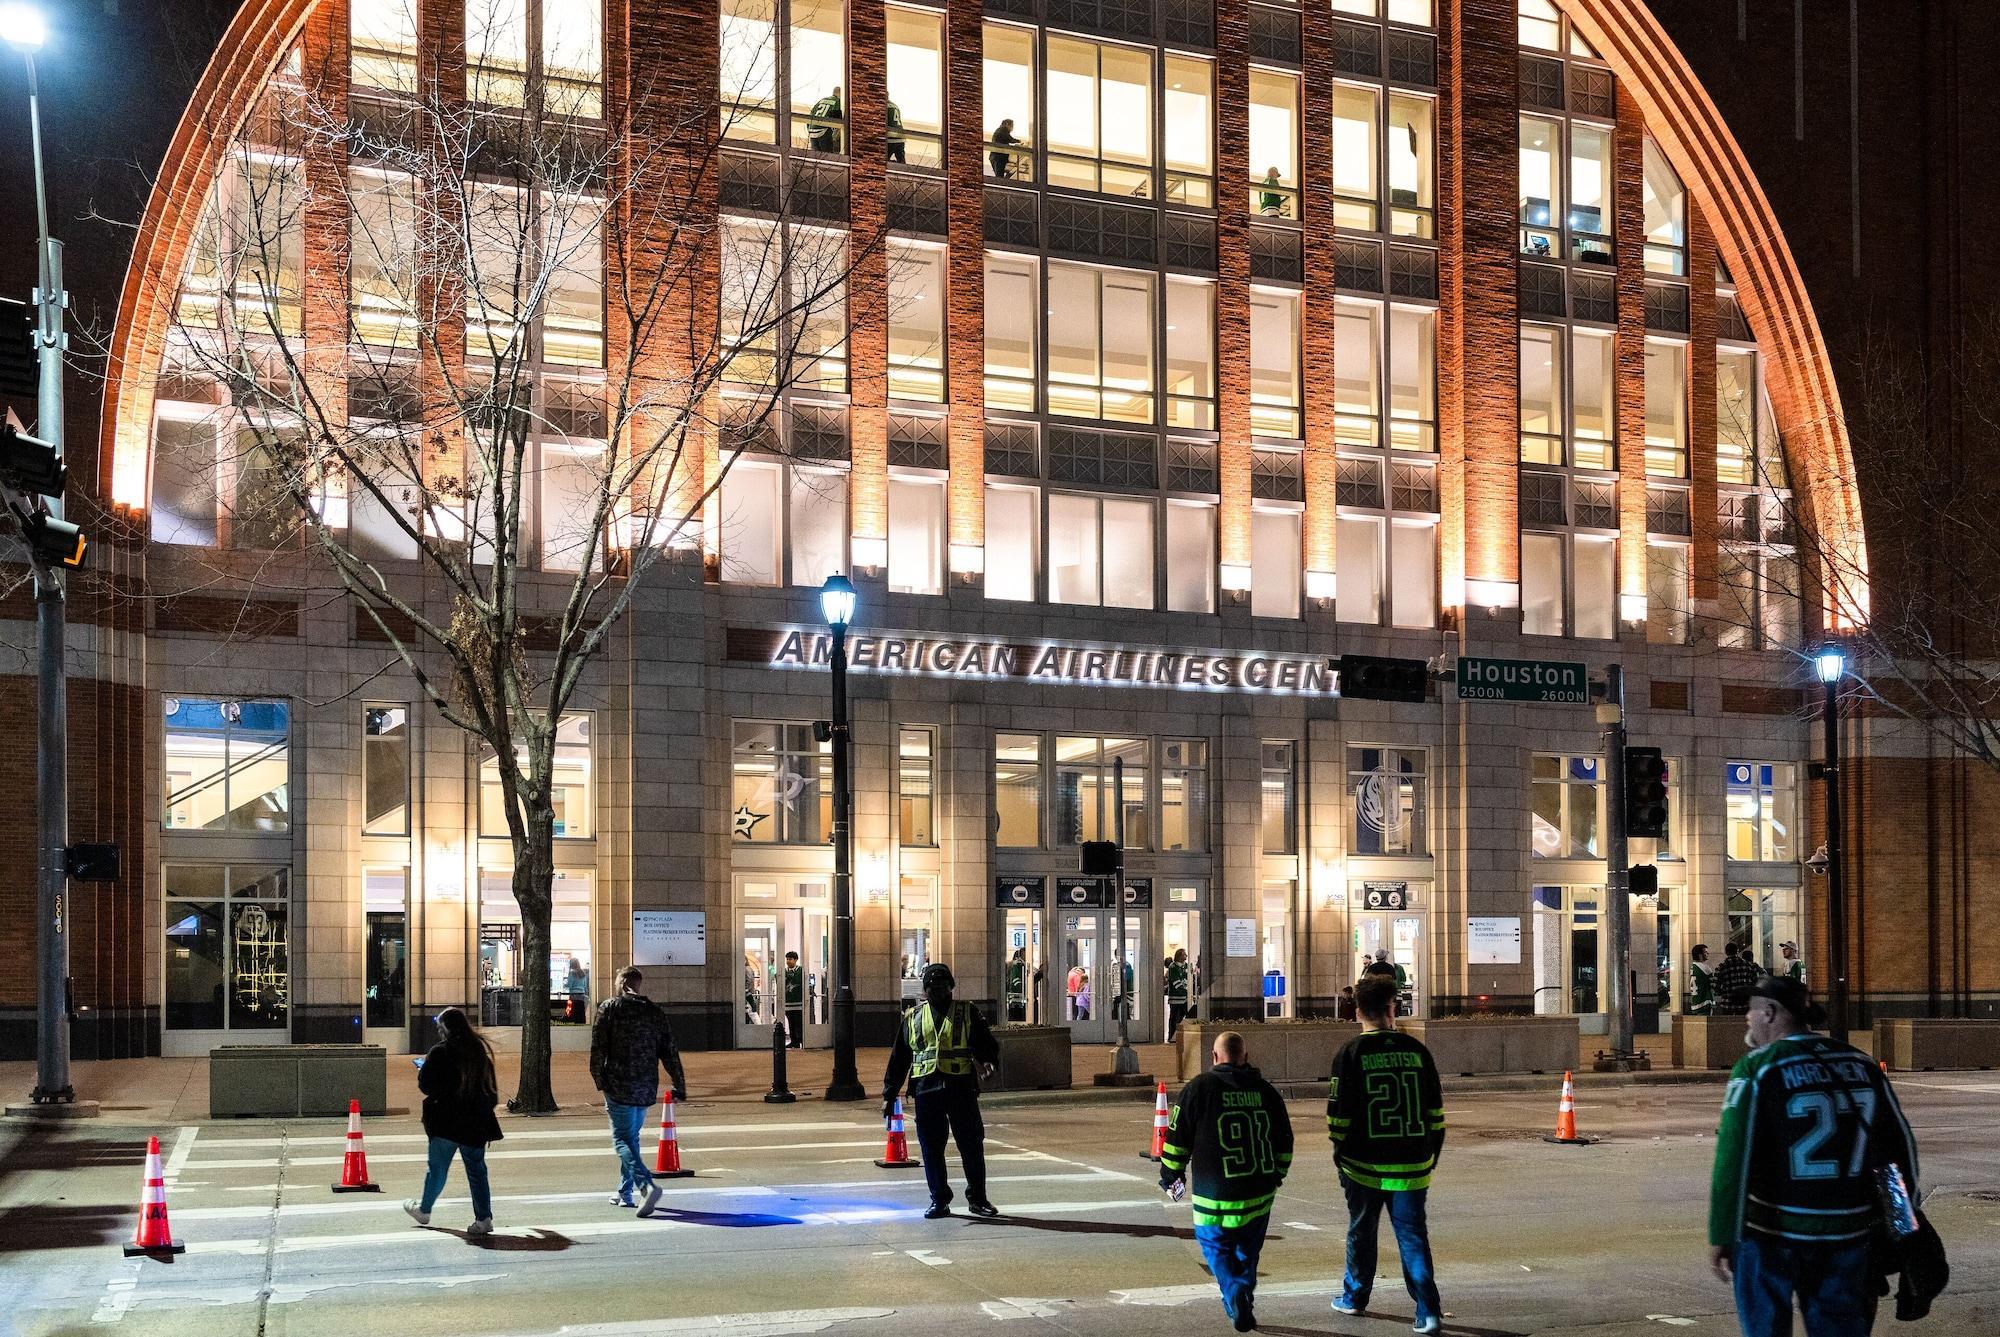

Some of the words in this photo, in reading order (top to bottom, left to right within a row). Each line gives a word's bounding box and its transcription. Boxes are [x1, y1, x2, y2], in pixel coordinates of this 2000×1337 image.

[775, 631, 1017, 675] AMERICAN
[1033, 646, 1232, 685] AIRLINES
[1244, 658, 1341, 691] CEN
[1467, 660, 1576, 686] Houston
[1461, 686, 1505, 699] 2500N
[1541, 690, 1585, 702] 2600N
[1360, 1051, 1423, 1071] ROBERTSON
[1222, 1091, 1263, 1107] SEGUIN
[1366, 1071, 1425, 1138] 21
[1217, 1110, 1275, 1179] 91
[1786, 1087, 1876, 1180] 27
